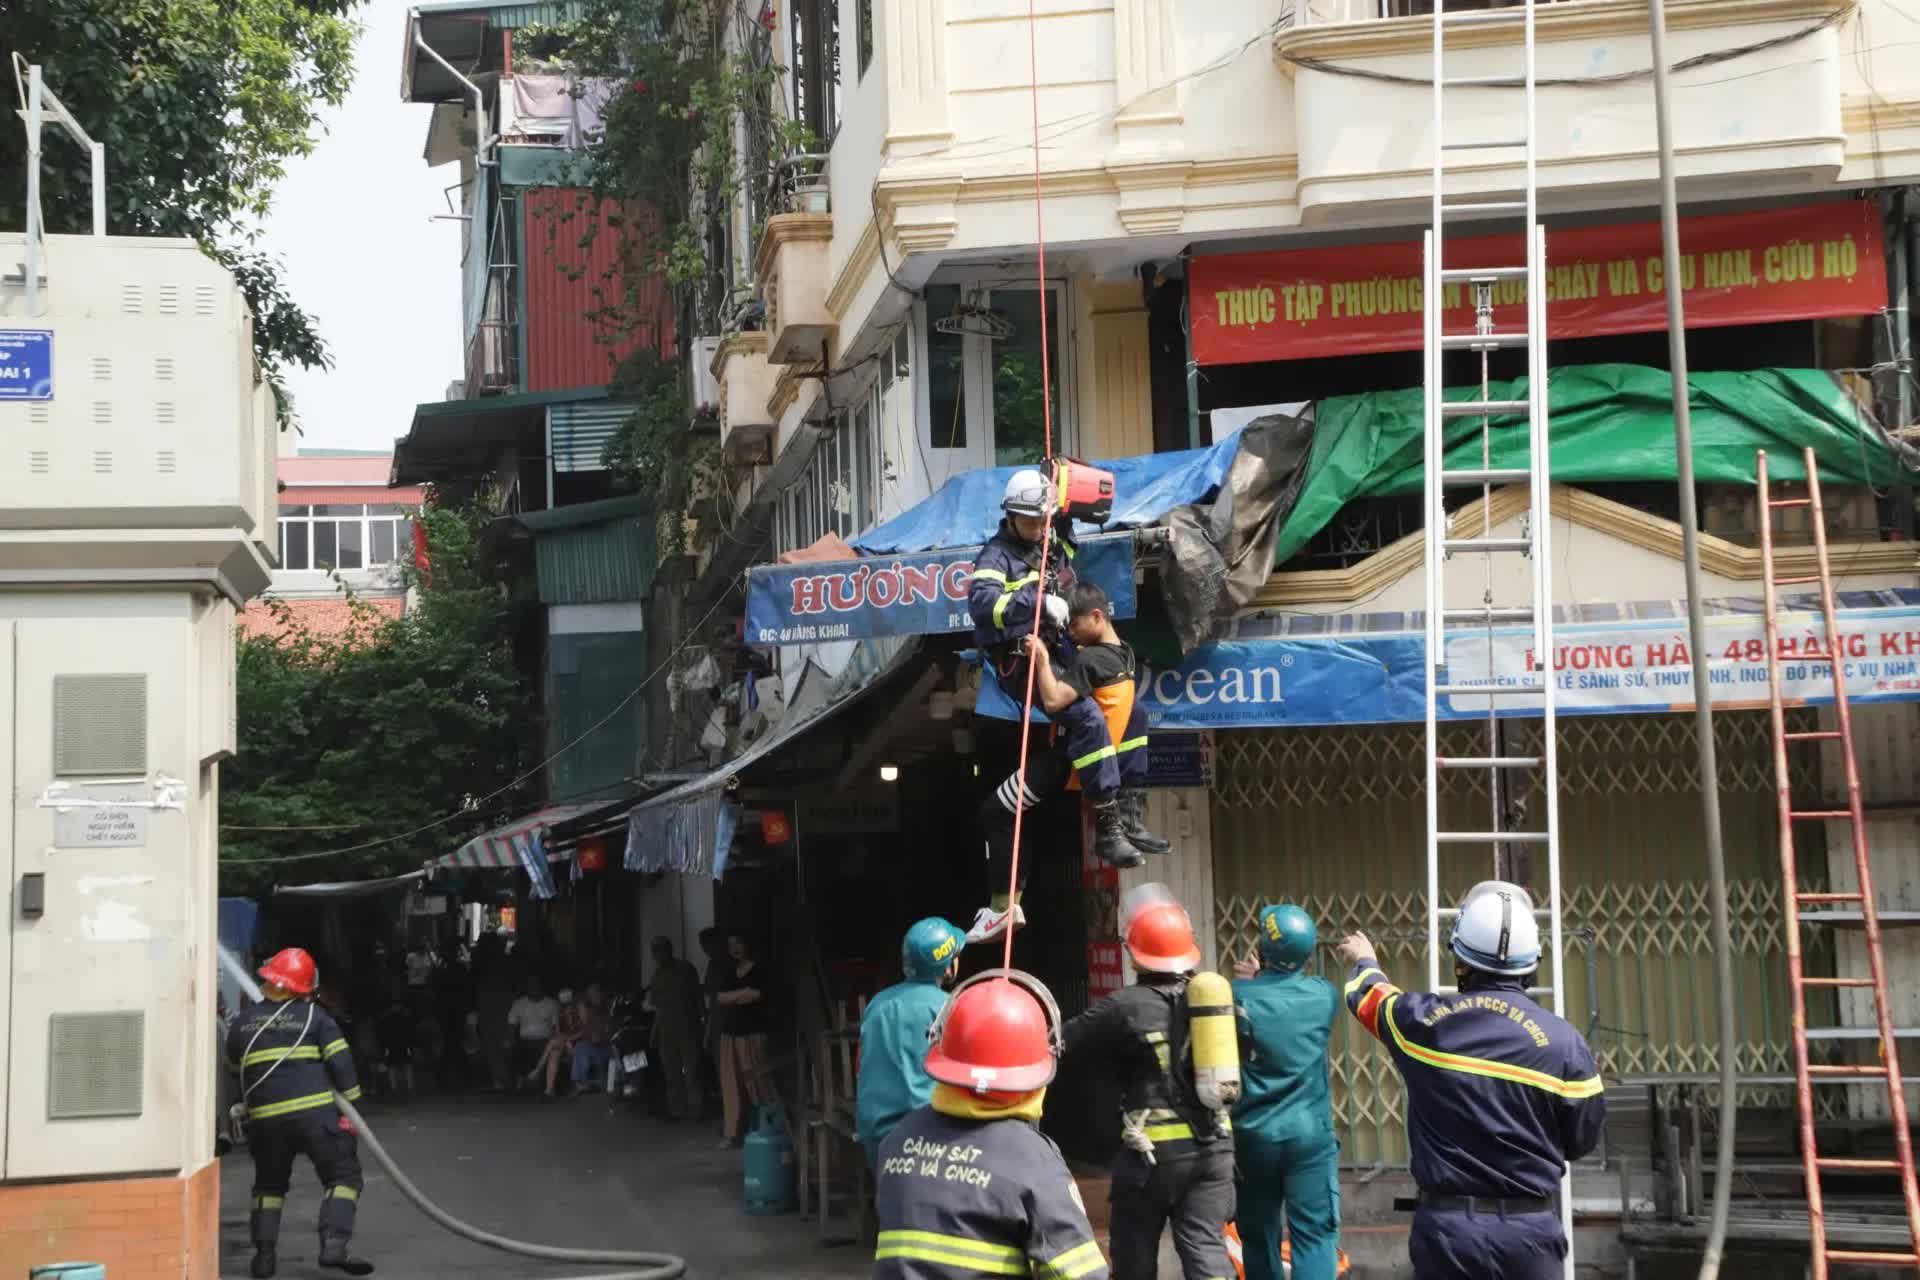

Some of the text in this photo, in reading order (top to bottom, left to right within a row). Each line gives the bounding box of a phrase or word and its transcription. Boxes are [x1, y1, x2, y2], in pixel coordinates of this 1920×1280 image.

[1216, 284, 1275, 330] THỰC
[1282, 280, 1323, 327] TẬP
[1330, 275, 1424, 318] PHƯƠNG
[1647, 255, 1695, 292] CU
[1765, 240, 1814, 282] CỨU
[1823, 234, 1857, 283] HỘ
[23, 367, 31, 379] 1
[791, 561, 976, 614] HƯƠNG
[1647, 635, 1690, 667] HÀ
[1723, 639, 1763, 662] 48
[1811, 664, 1854, 680] PHC
[1476, 996, 1508, 1014] PCCC
[944, 1163, 992, 1189] CNCH
